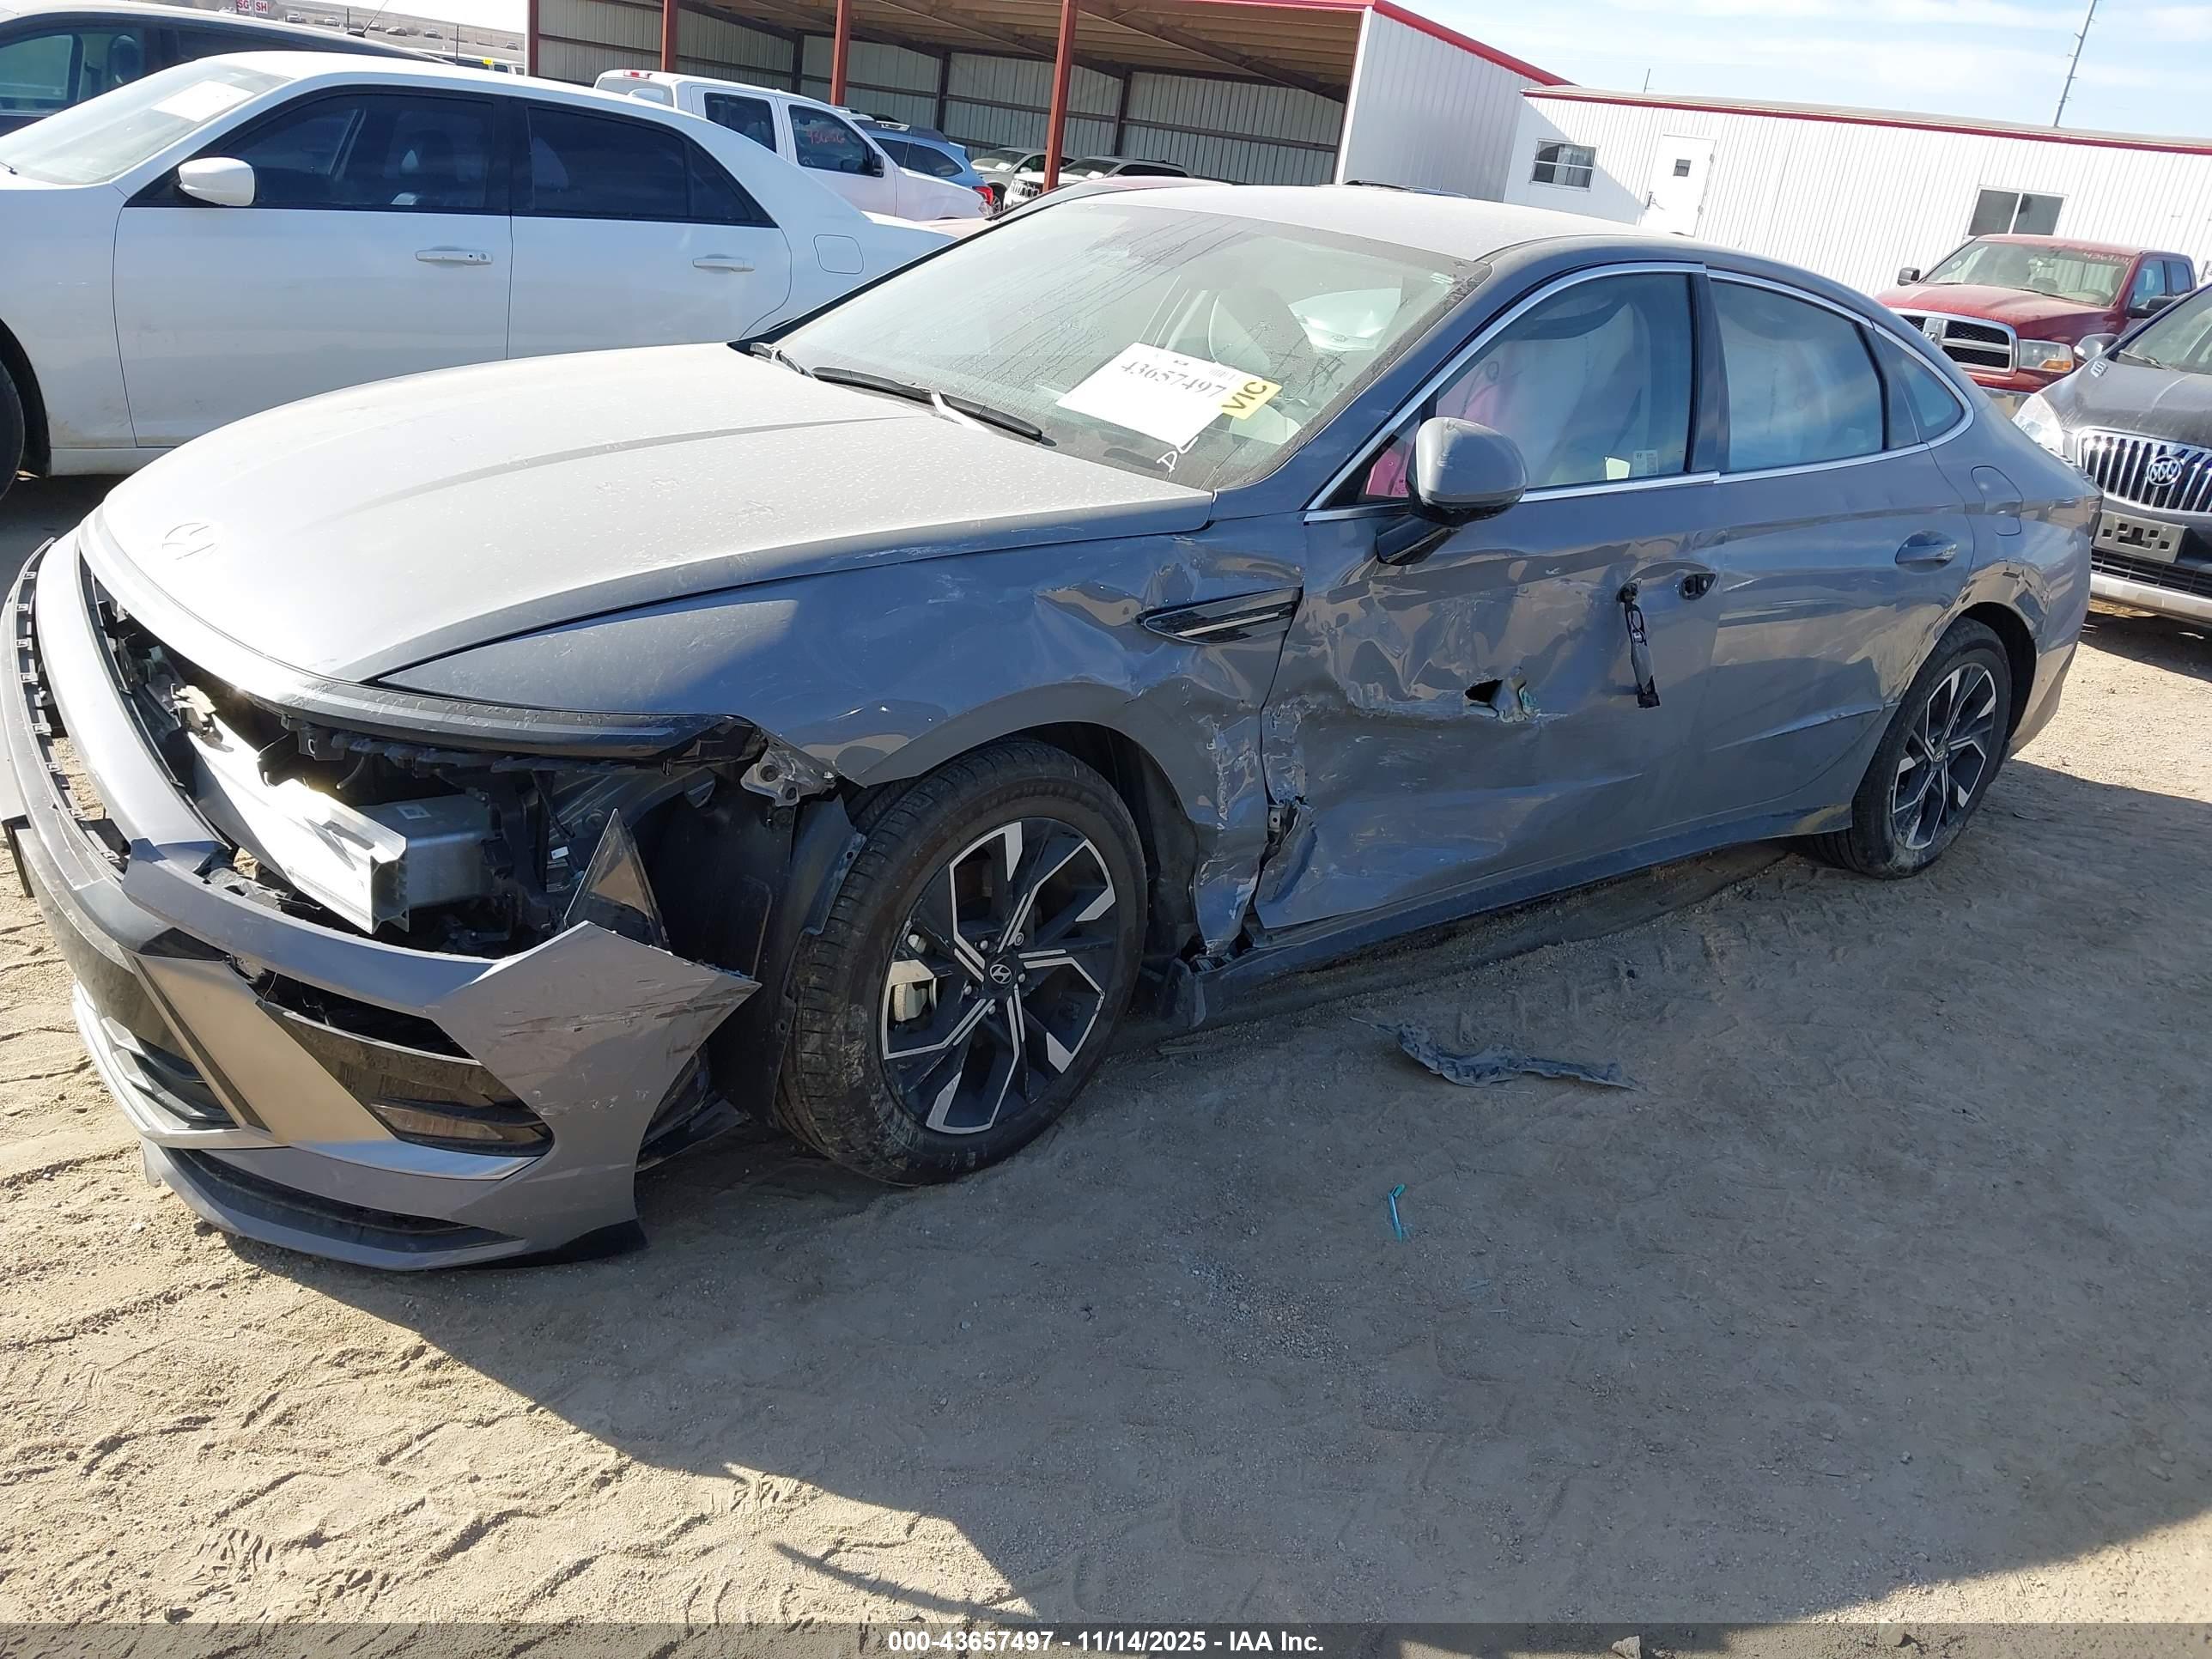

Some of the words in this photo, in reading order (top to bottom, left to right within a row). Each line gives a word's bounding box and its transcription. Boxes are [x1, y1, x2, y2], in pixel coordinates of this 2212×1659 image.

[255, 2, 267, 12] SH
[1121, 361, 1228, 398] 43657497
[1220, 380, 1268, 411] VIC
